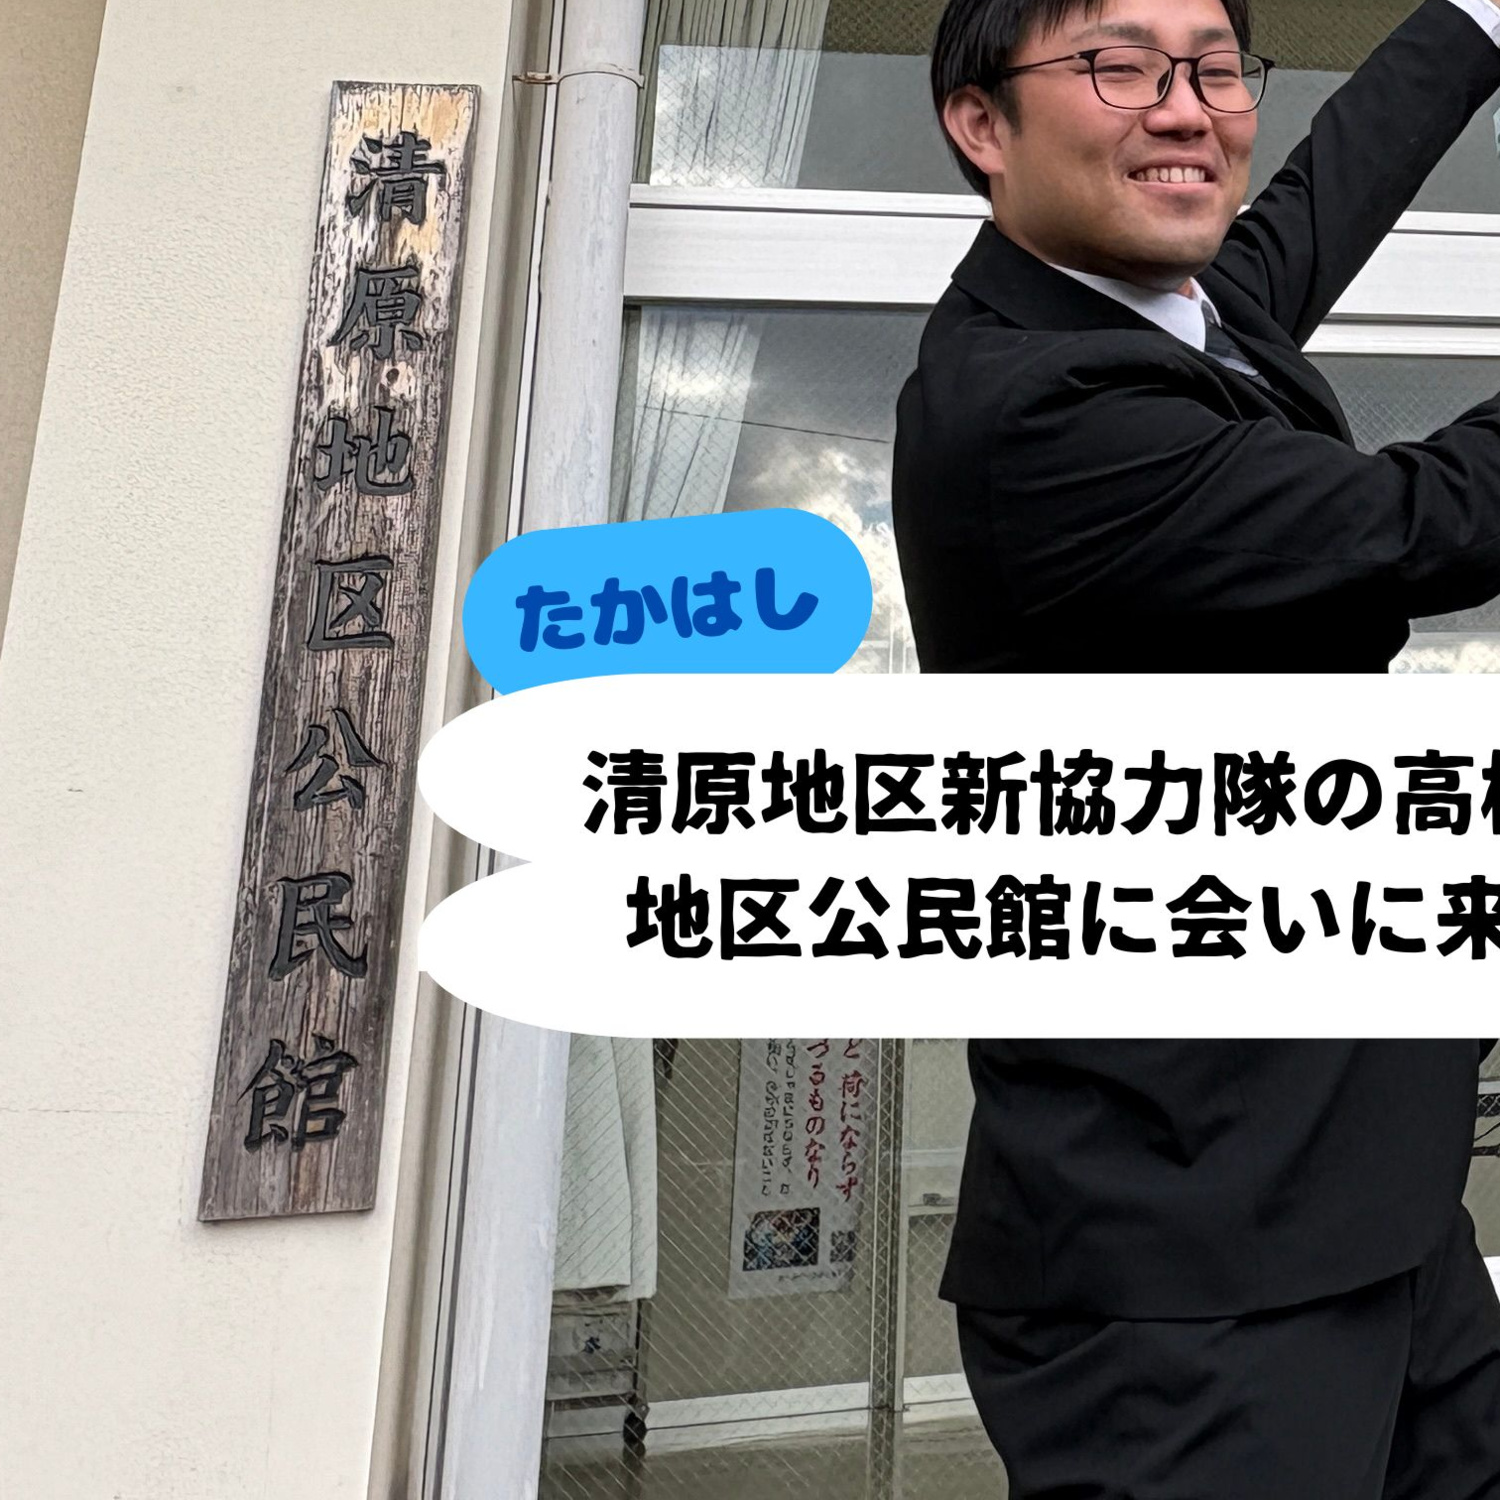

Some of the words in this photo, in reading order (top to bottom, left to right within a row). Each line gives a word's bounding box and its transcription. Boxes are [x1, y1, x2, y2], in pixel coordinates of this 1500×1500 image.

[242, 129, 447, 1158] 清原地区公民館
